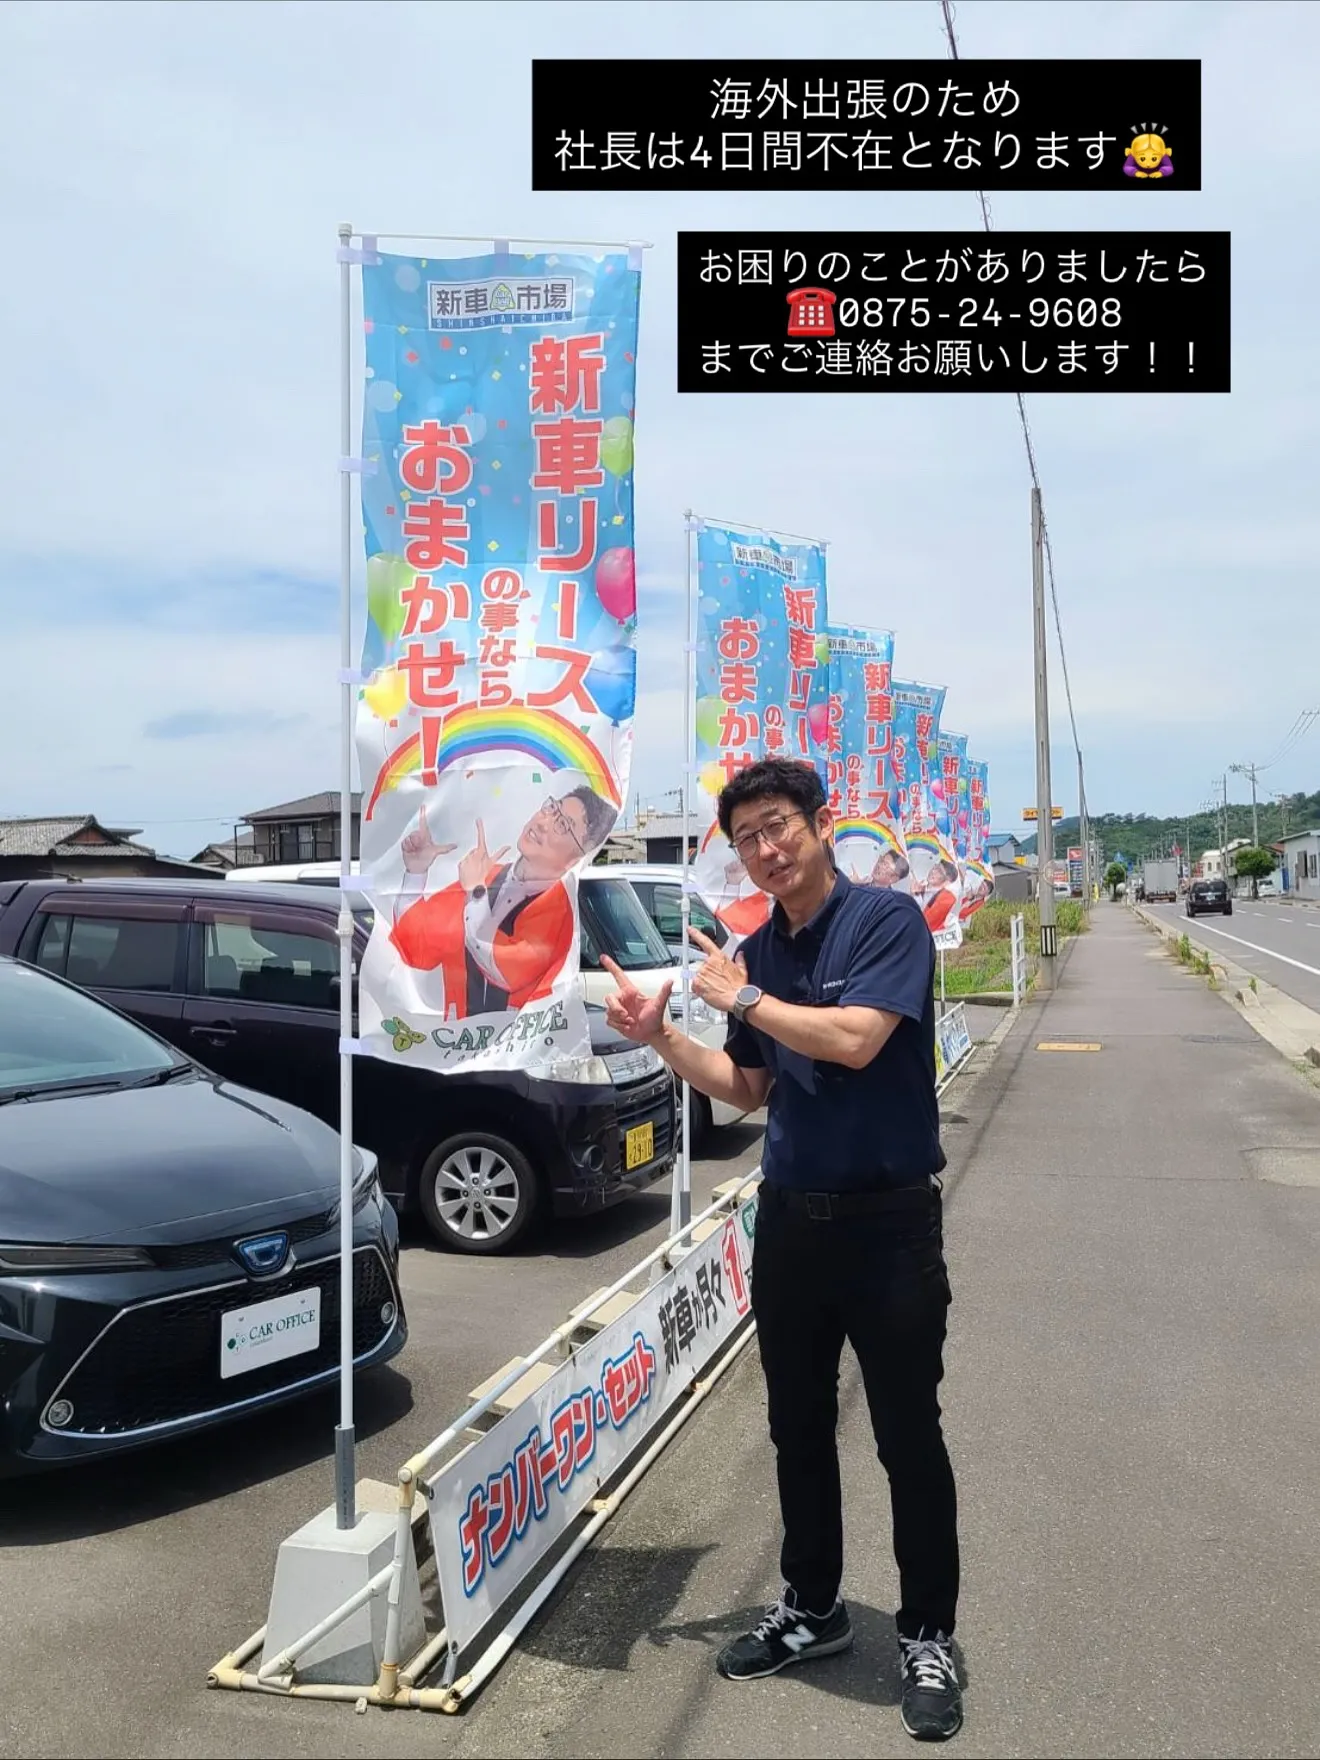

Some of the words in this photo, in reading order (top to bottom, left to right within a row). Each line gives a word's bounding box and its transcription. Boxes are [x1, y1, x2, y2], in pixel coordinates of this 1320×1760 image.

[530, 335, 604, 715] 新車リース
[479, 569, 520, 707] の事なら
[864, 663, 894, 819] 新車リース
[431, 1025, 495, 1051] CAR
[249, 1322, 274, 1340] CAR
[275, 1309, 316, 1332] OFFICE
[459, 1330, 656, 1598] ナンバーワン・セット
